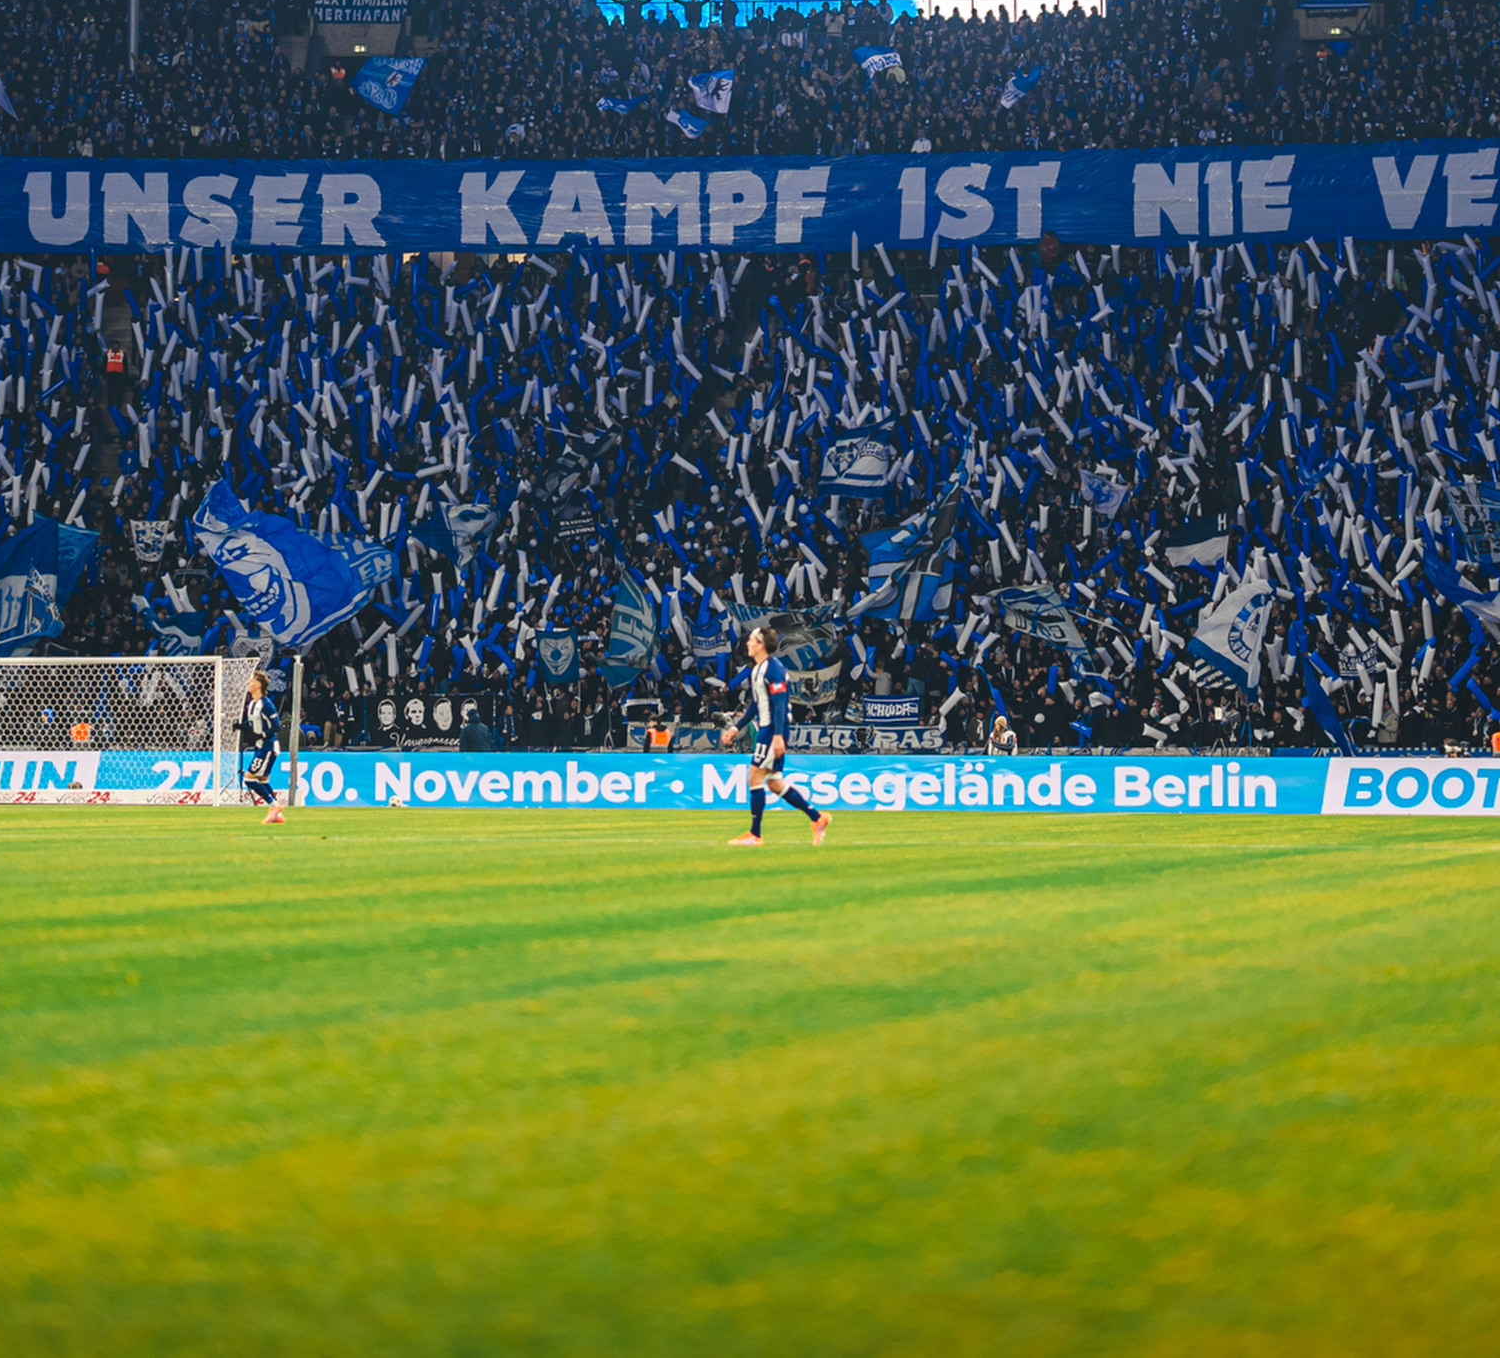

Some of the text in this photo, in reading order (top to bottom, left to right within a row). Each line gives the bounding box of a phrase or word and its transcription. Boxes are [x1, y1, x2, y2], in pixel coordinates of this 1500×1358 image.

[24, 171, 386, 247] UNSER
[459, 166, 830, 245] KAMPF
[898, 161, 1061, 241] IST
[1133, 154, 1296, 237] NIE
[375, 760, 655, 803] November
[702, 761, 1096, 811] Mssegelände
[1113, 761, 1277, 808] Berlin
